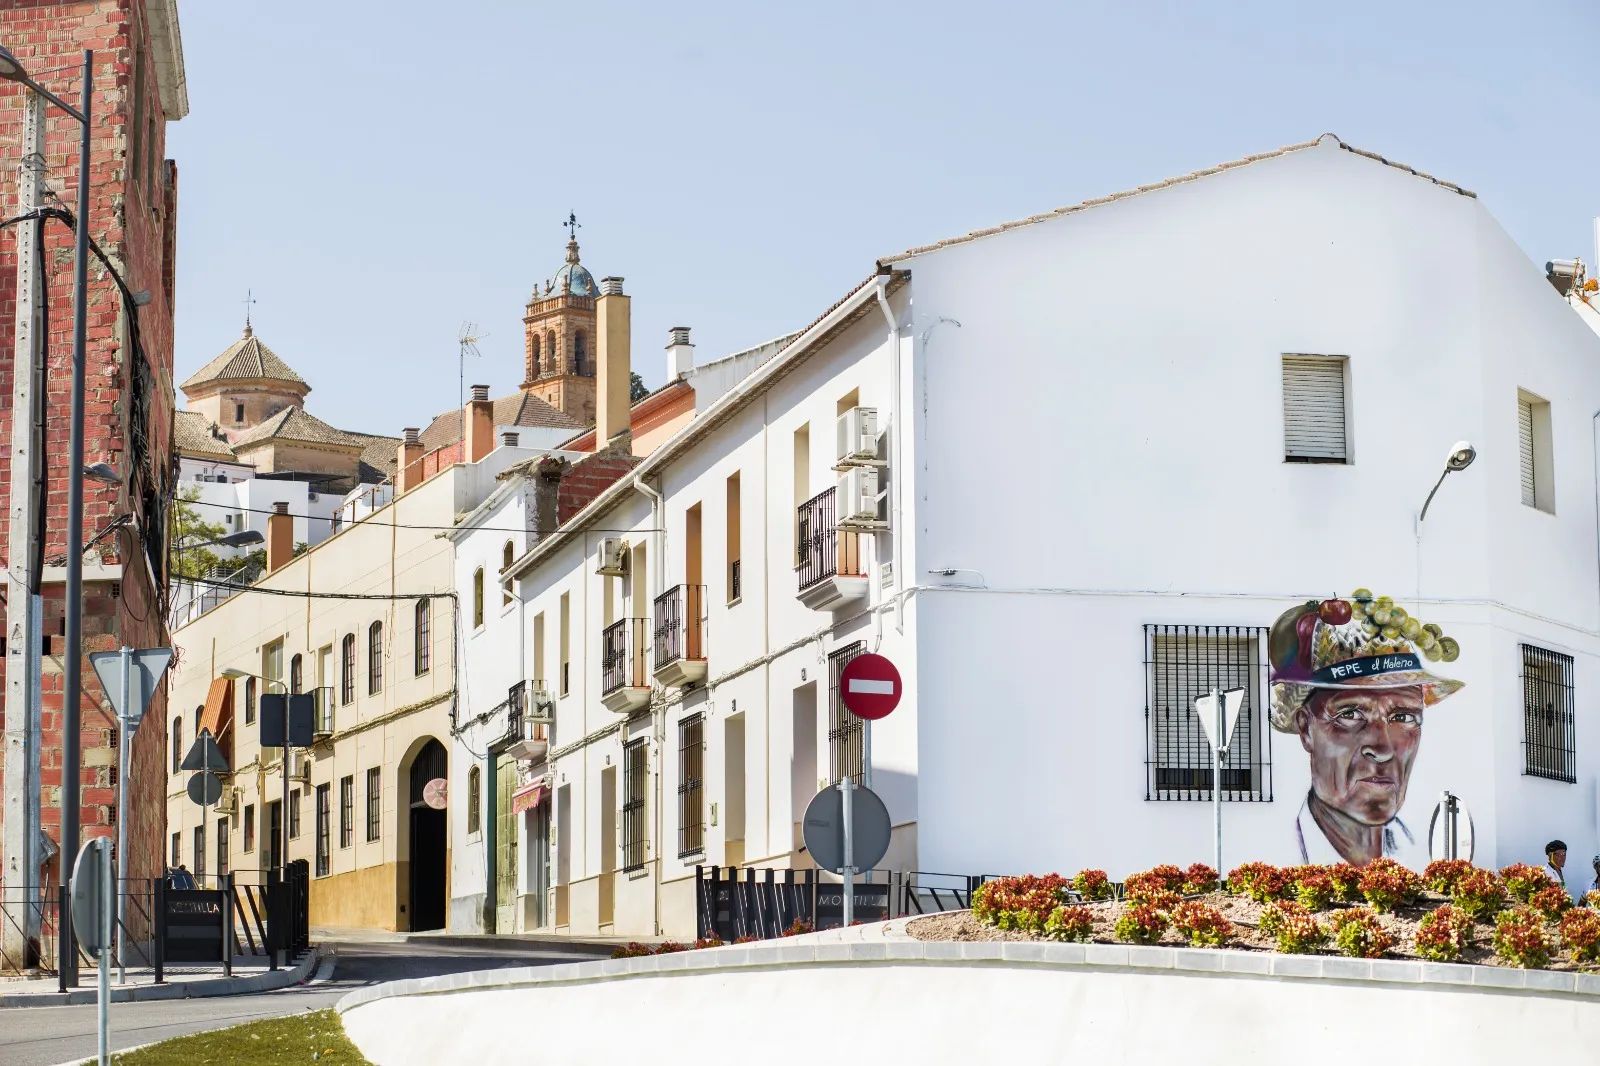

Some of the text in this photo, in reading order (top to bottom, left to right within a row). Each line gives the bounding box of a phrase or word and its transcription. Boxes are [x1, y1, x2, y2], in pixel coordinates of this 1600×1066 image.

[1331, 656, 1413, 679] PEPE el Maleno
[818, 895, 887, 906] MOTILL
